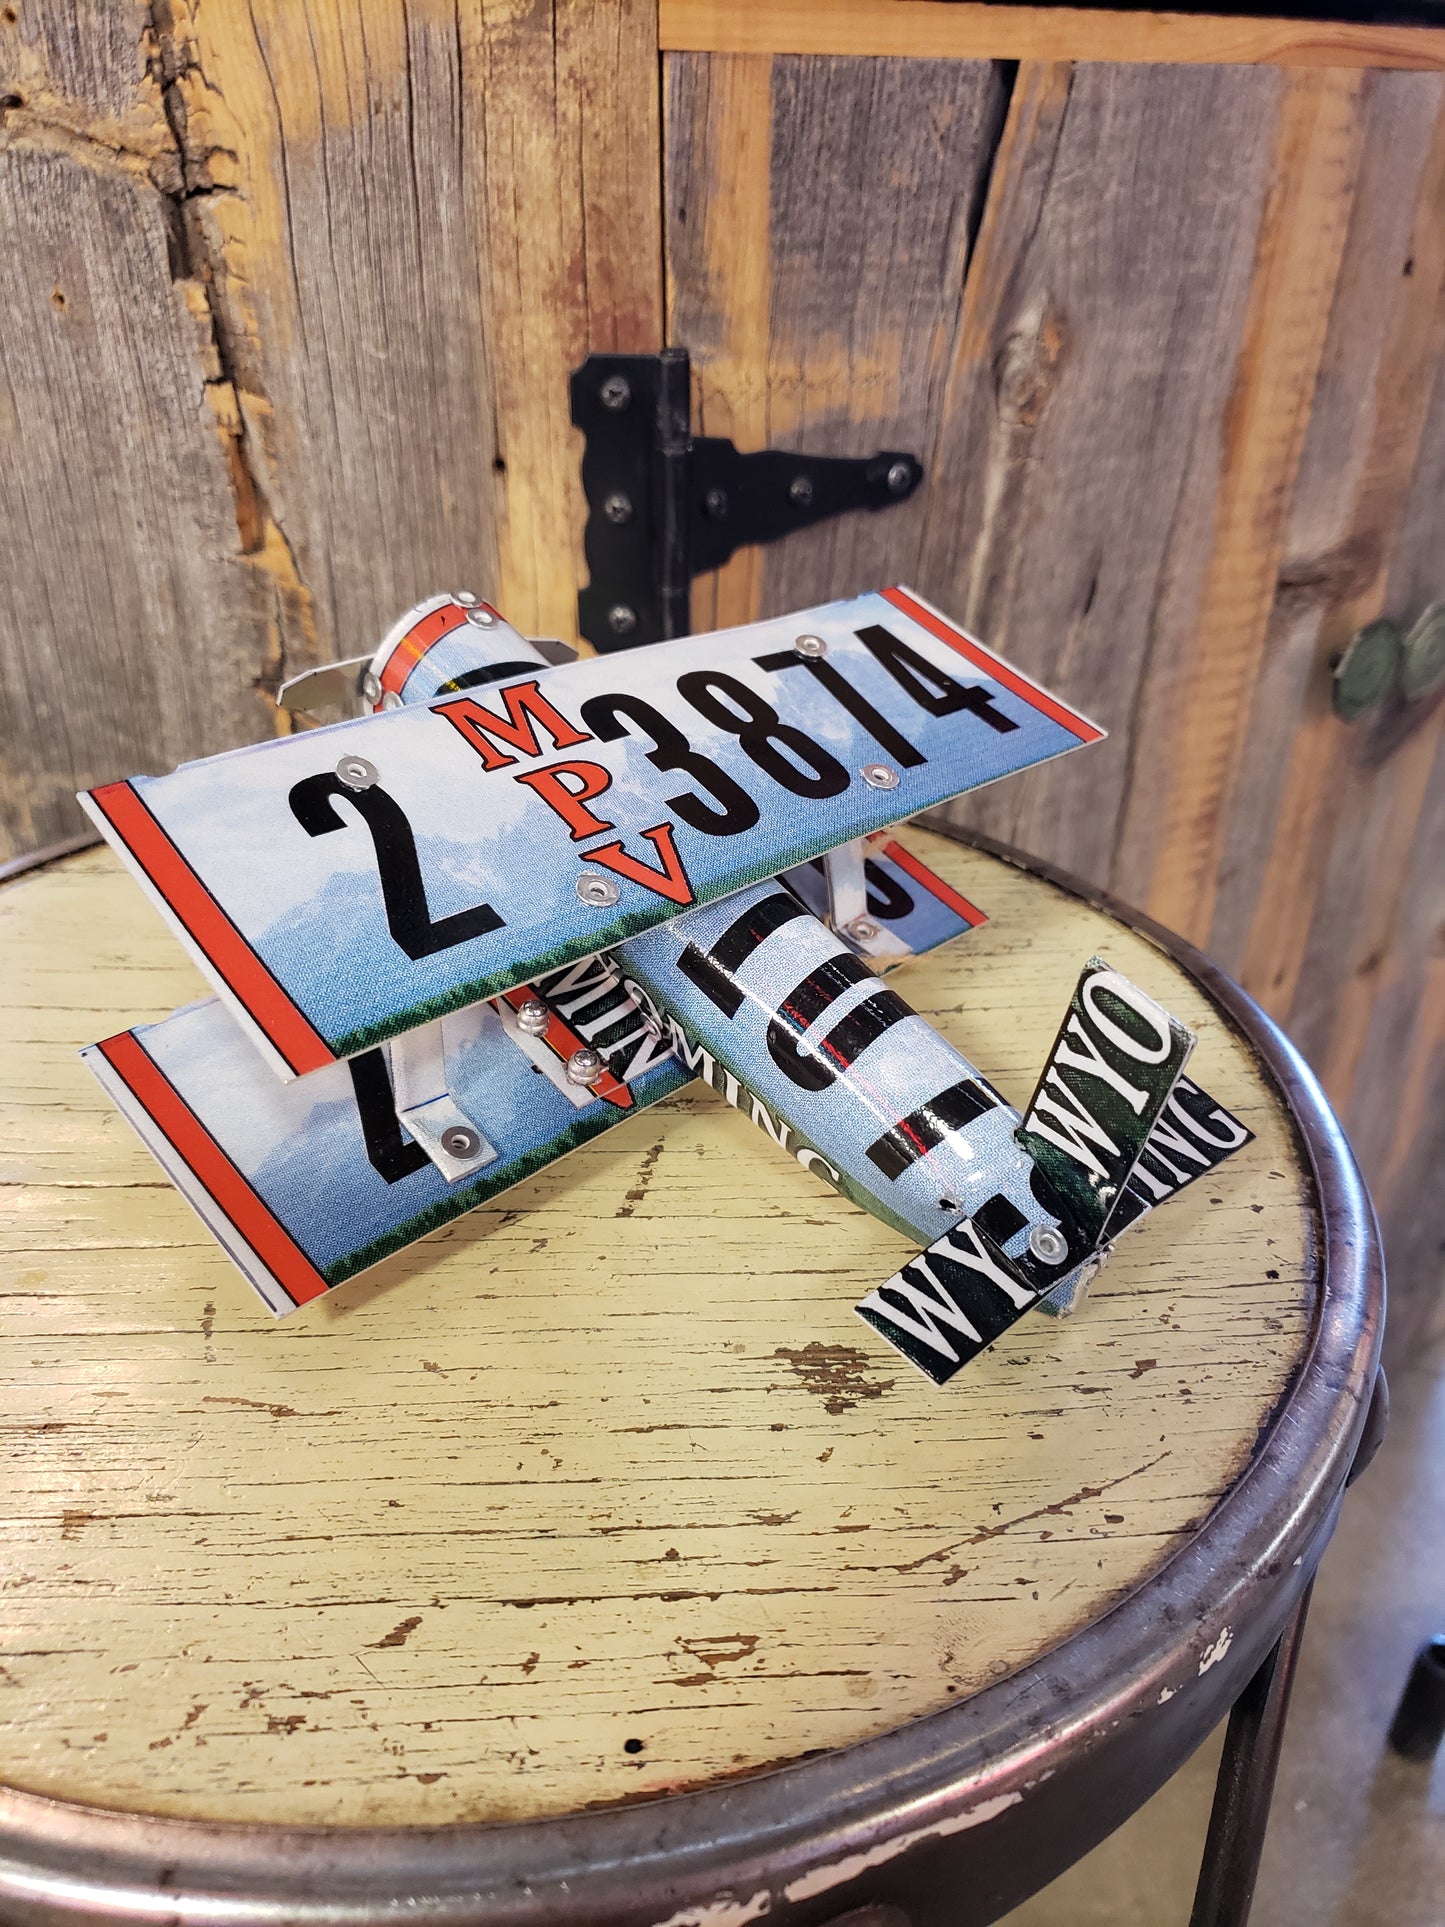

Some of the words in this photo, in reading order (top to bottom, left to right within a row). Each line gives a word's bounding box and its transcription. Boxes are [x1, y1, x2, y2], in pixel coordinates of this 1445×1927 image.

[288, 770, 505, 961] 2
[579, 624, 1020, 836] 3874
[1024, 970, 1173, 1180] WYO
[855, 1217, 1038, 1363] WY
